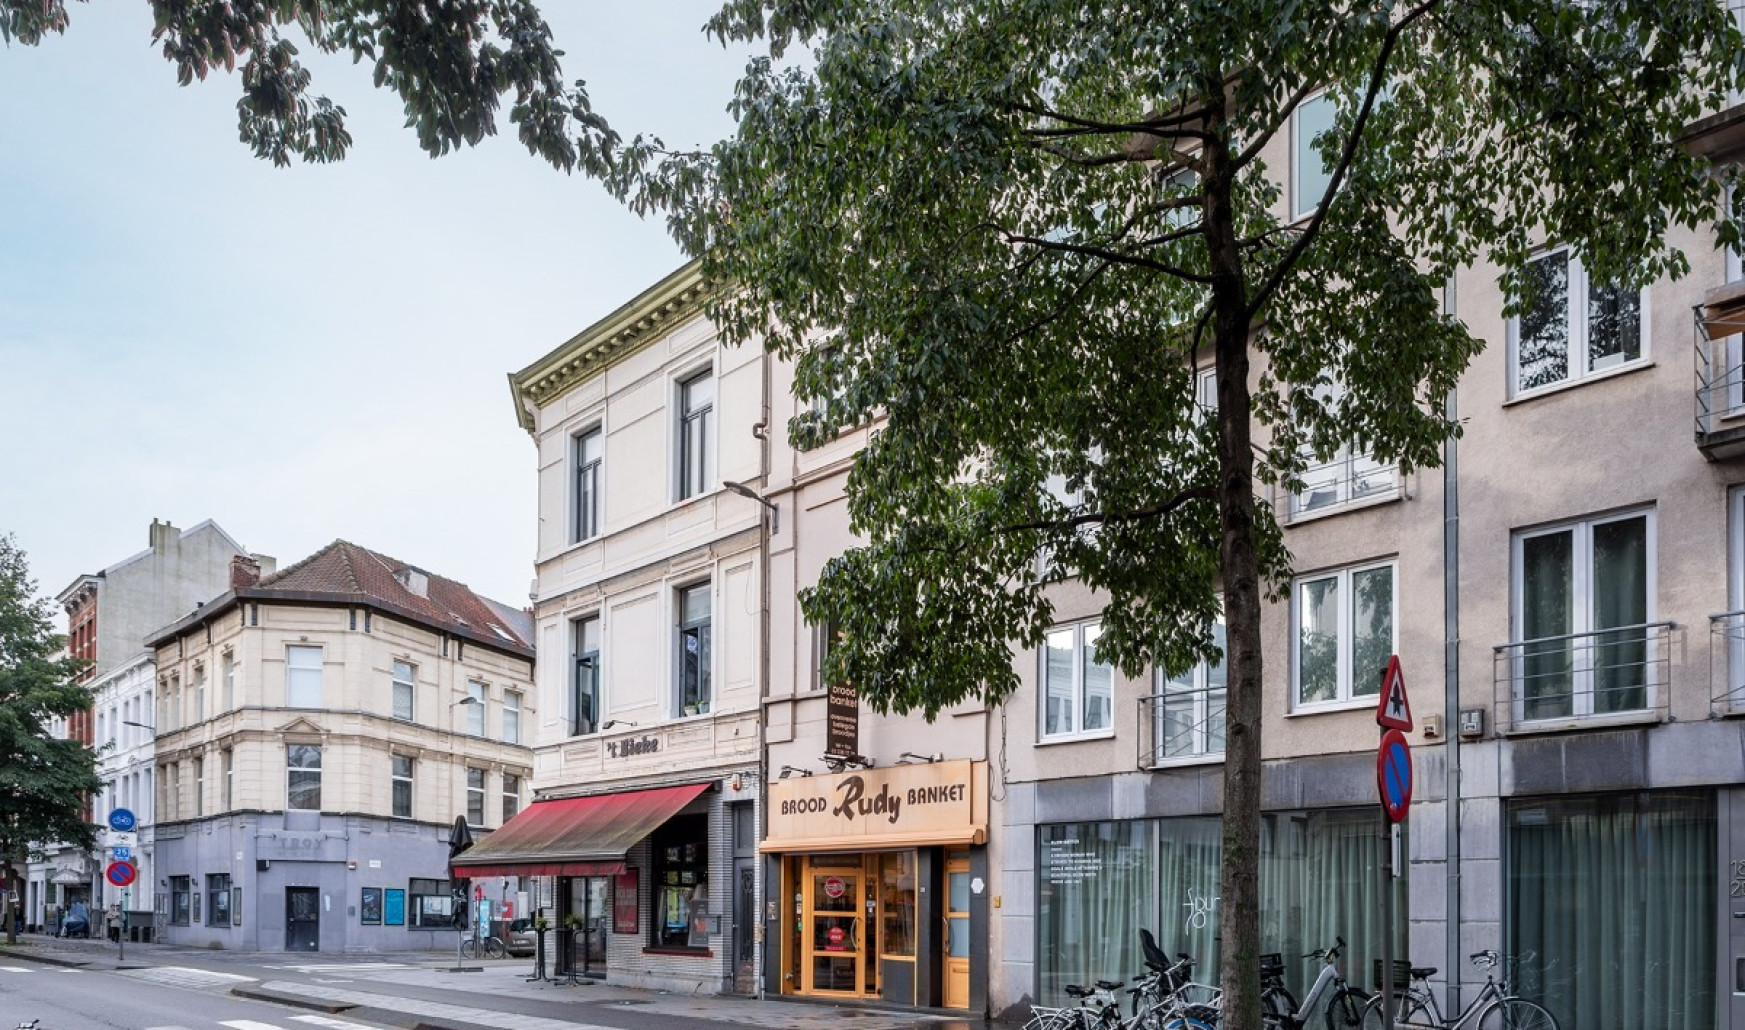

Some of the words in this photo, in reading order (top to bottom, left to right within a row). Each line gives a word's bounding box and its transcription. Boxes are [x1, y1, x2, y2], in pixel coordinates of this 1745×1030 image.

[832, 686, 856, 698] brood
[830, 694, 857, 708] banket
[782, 797, 827, 816] BROOD
[833, 775, 902, 824] Rudy
[907, 783, 966, 806] BANKET
